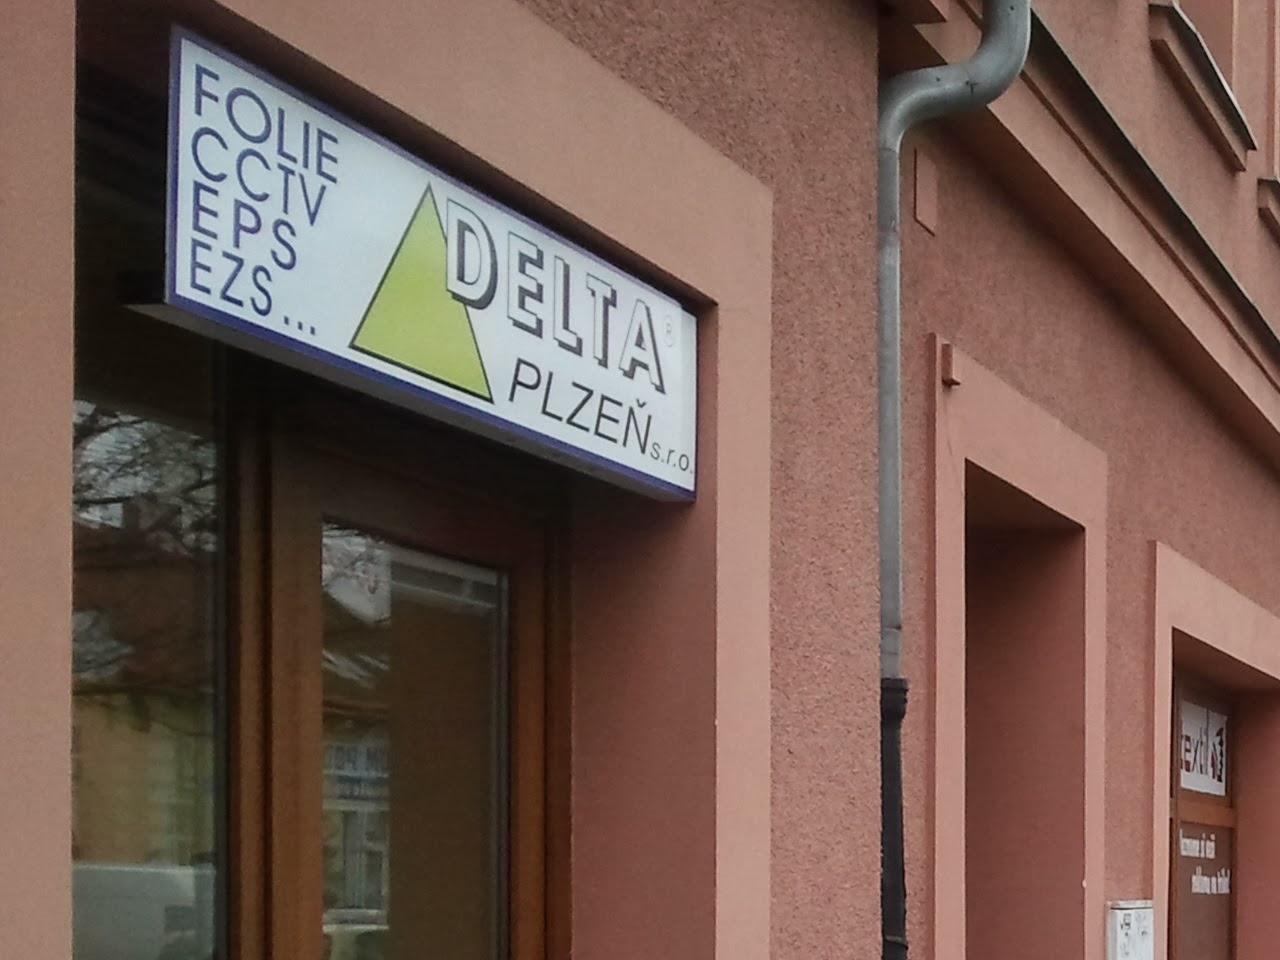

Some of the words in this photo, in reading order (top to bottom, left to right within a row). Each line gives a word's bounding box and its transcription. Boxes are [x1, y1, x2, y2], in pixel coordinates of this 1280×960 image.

[194, 63, 340, 184] FOLIE
[190, 126, 327, 227] CCTV
[191, 180, 298, 271] EPS
[445, 197, 667, 394] DELTA
[508, 357, 653, 457] PLZEŇ
